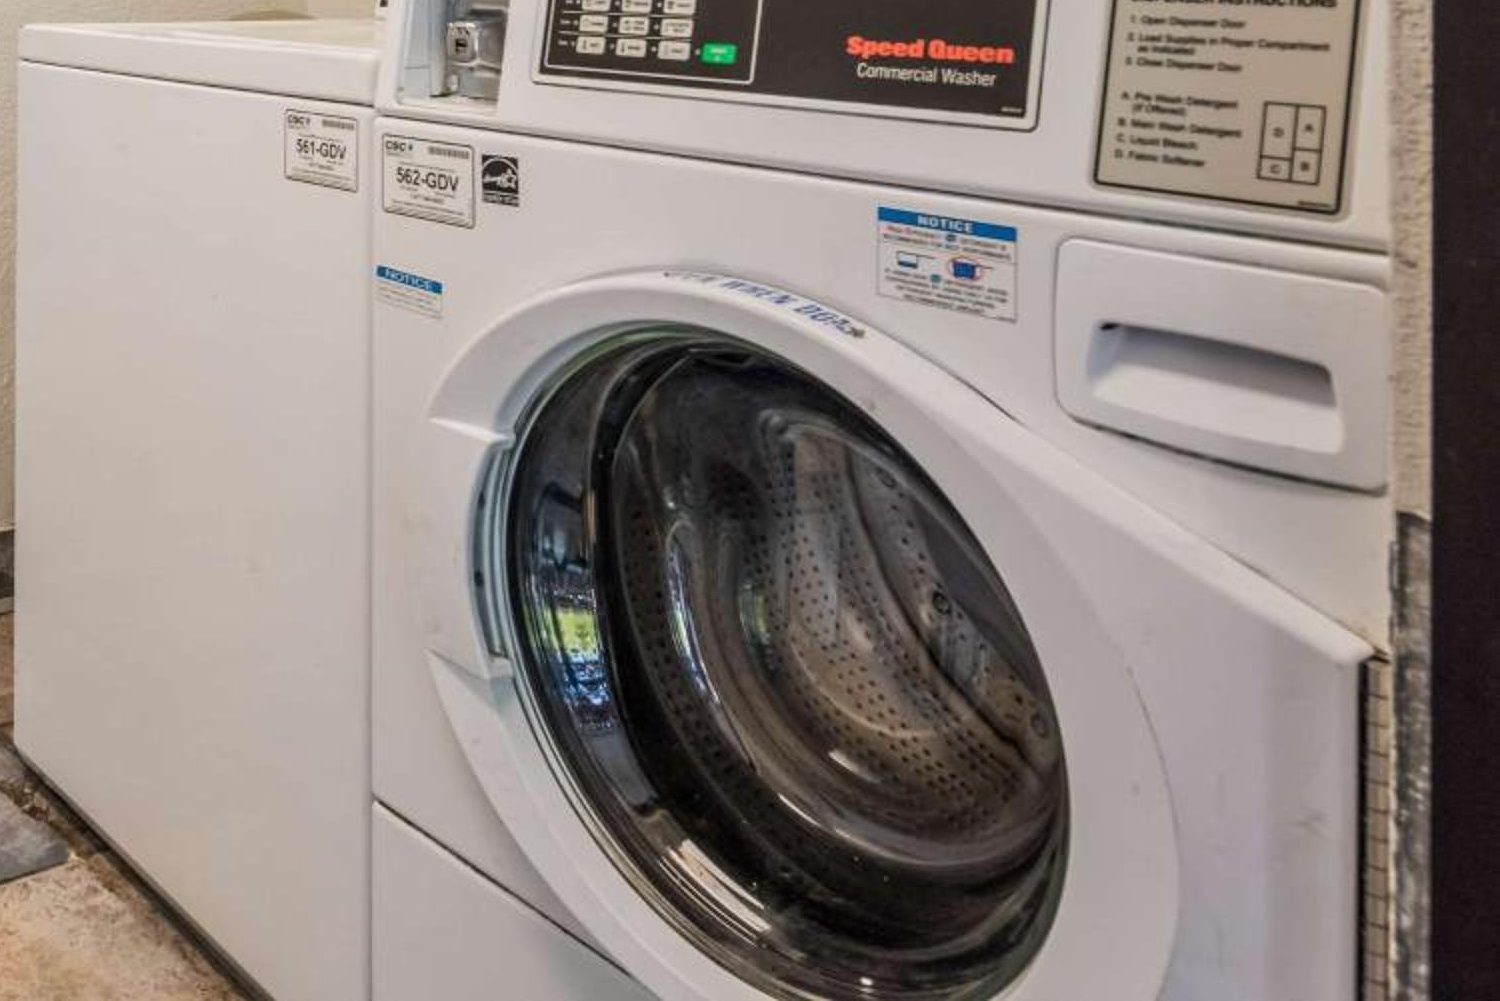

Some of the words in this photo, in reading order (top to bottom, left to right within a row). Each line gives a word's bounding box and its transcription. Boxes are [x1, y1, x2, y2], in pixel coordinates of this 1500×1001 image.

[846, 35, 925, 60] Speed
[928, 39, 1015, 64] Queen
[856, 62, 937, 83] Commercial
[941, 67, 997, 87] Washer
[295, 138, 347, 160] 561-GDV
[385, 140, 407, 152] CSC
[395, 166, 459, 192] 562-GDV
[1269, 163, 1280, 174] C
[916, 214, 974, 233] NOTICE
[384, 267, 433, 291] NOTICE
